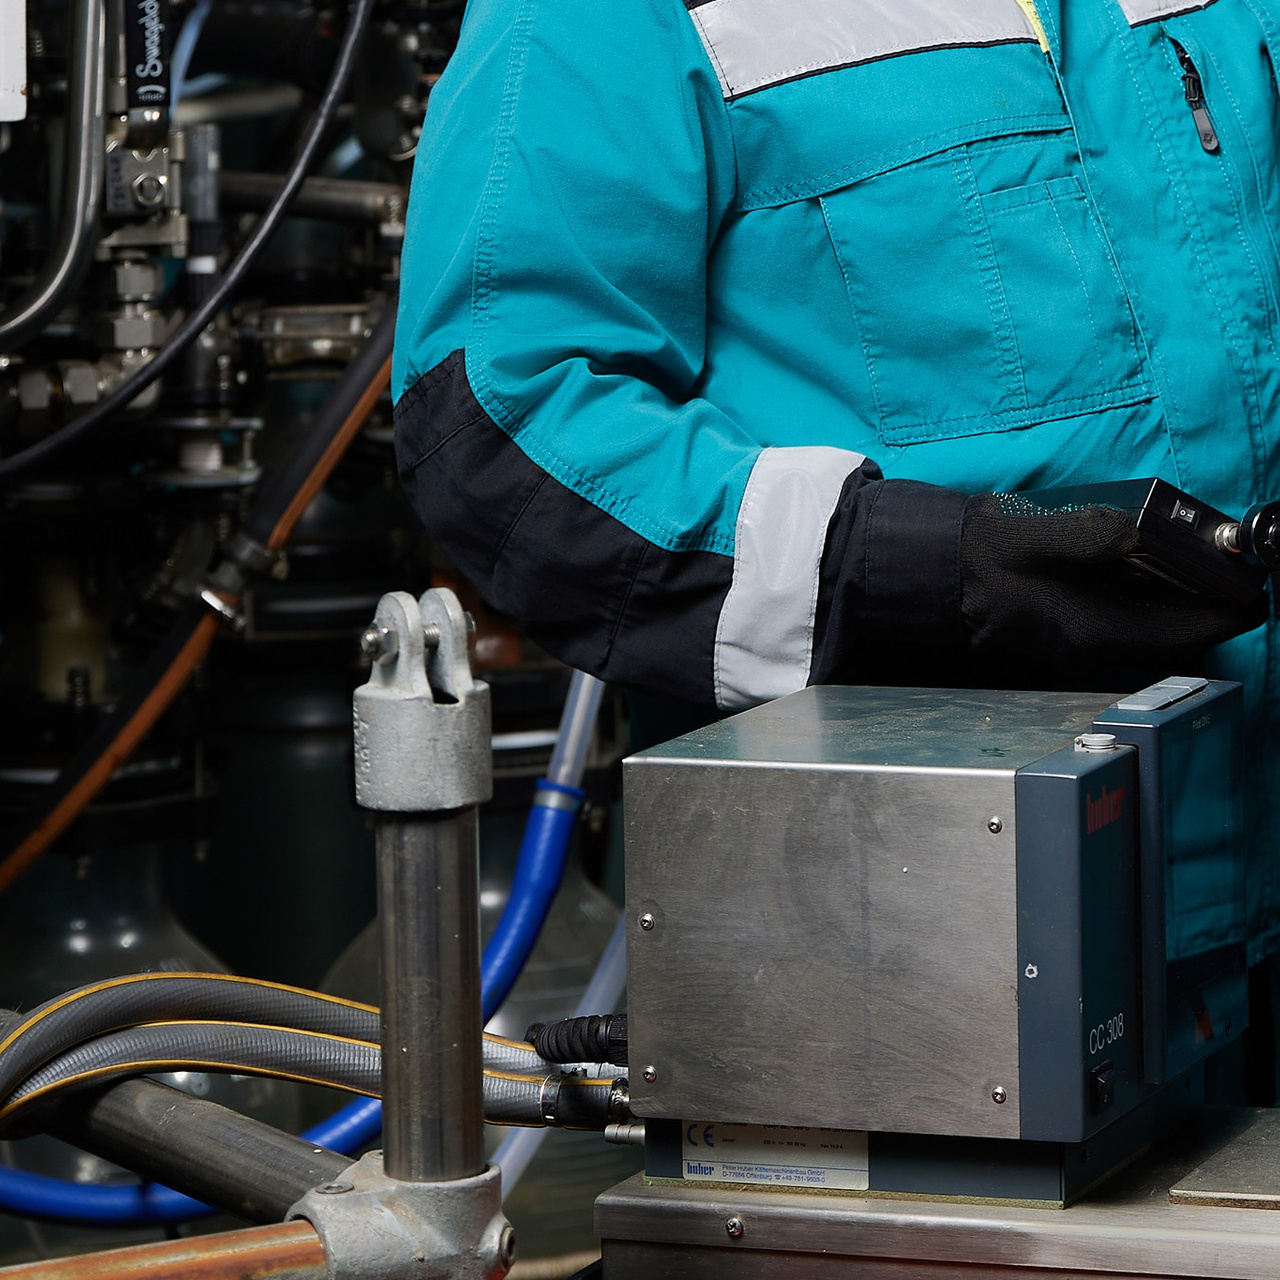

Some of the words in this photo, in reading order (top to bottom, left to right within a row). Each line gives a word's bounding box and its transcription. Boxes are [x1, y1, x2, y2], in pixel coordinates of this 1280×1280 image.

[1085, 784, 1126, 836] huber
[1089, 1023, 1105, 1055] CC
[1106, 1012, 1125, 1044] 308
[686, 1162, 715, 1176] huber
